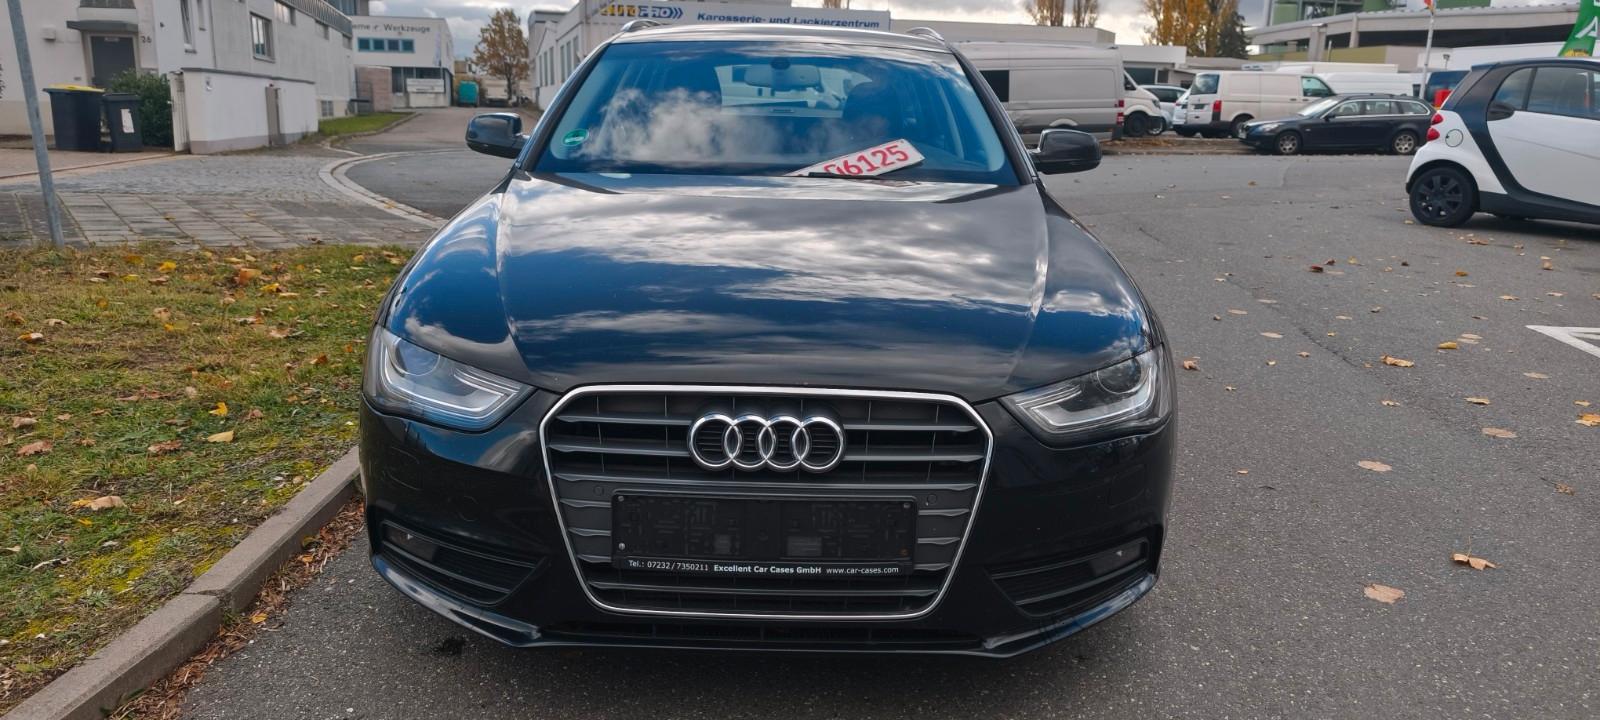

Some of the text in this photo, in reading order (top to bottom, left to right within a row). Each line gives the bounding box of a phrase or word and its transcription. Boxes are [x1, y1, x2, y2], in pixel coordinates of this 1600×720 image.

[697, 12, 766, 24] Karosserie-
[769, 17, 791, 25] und
[384, 23, 431, 34] Werkzeuge
[628, 560, 899, 574] Tel.: 07232/7350211 Excellent Car Cases GmbH www.car-cases.com
